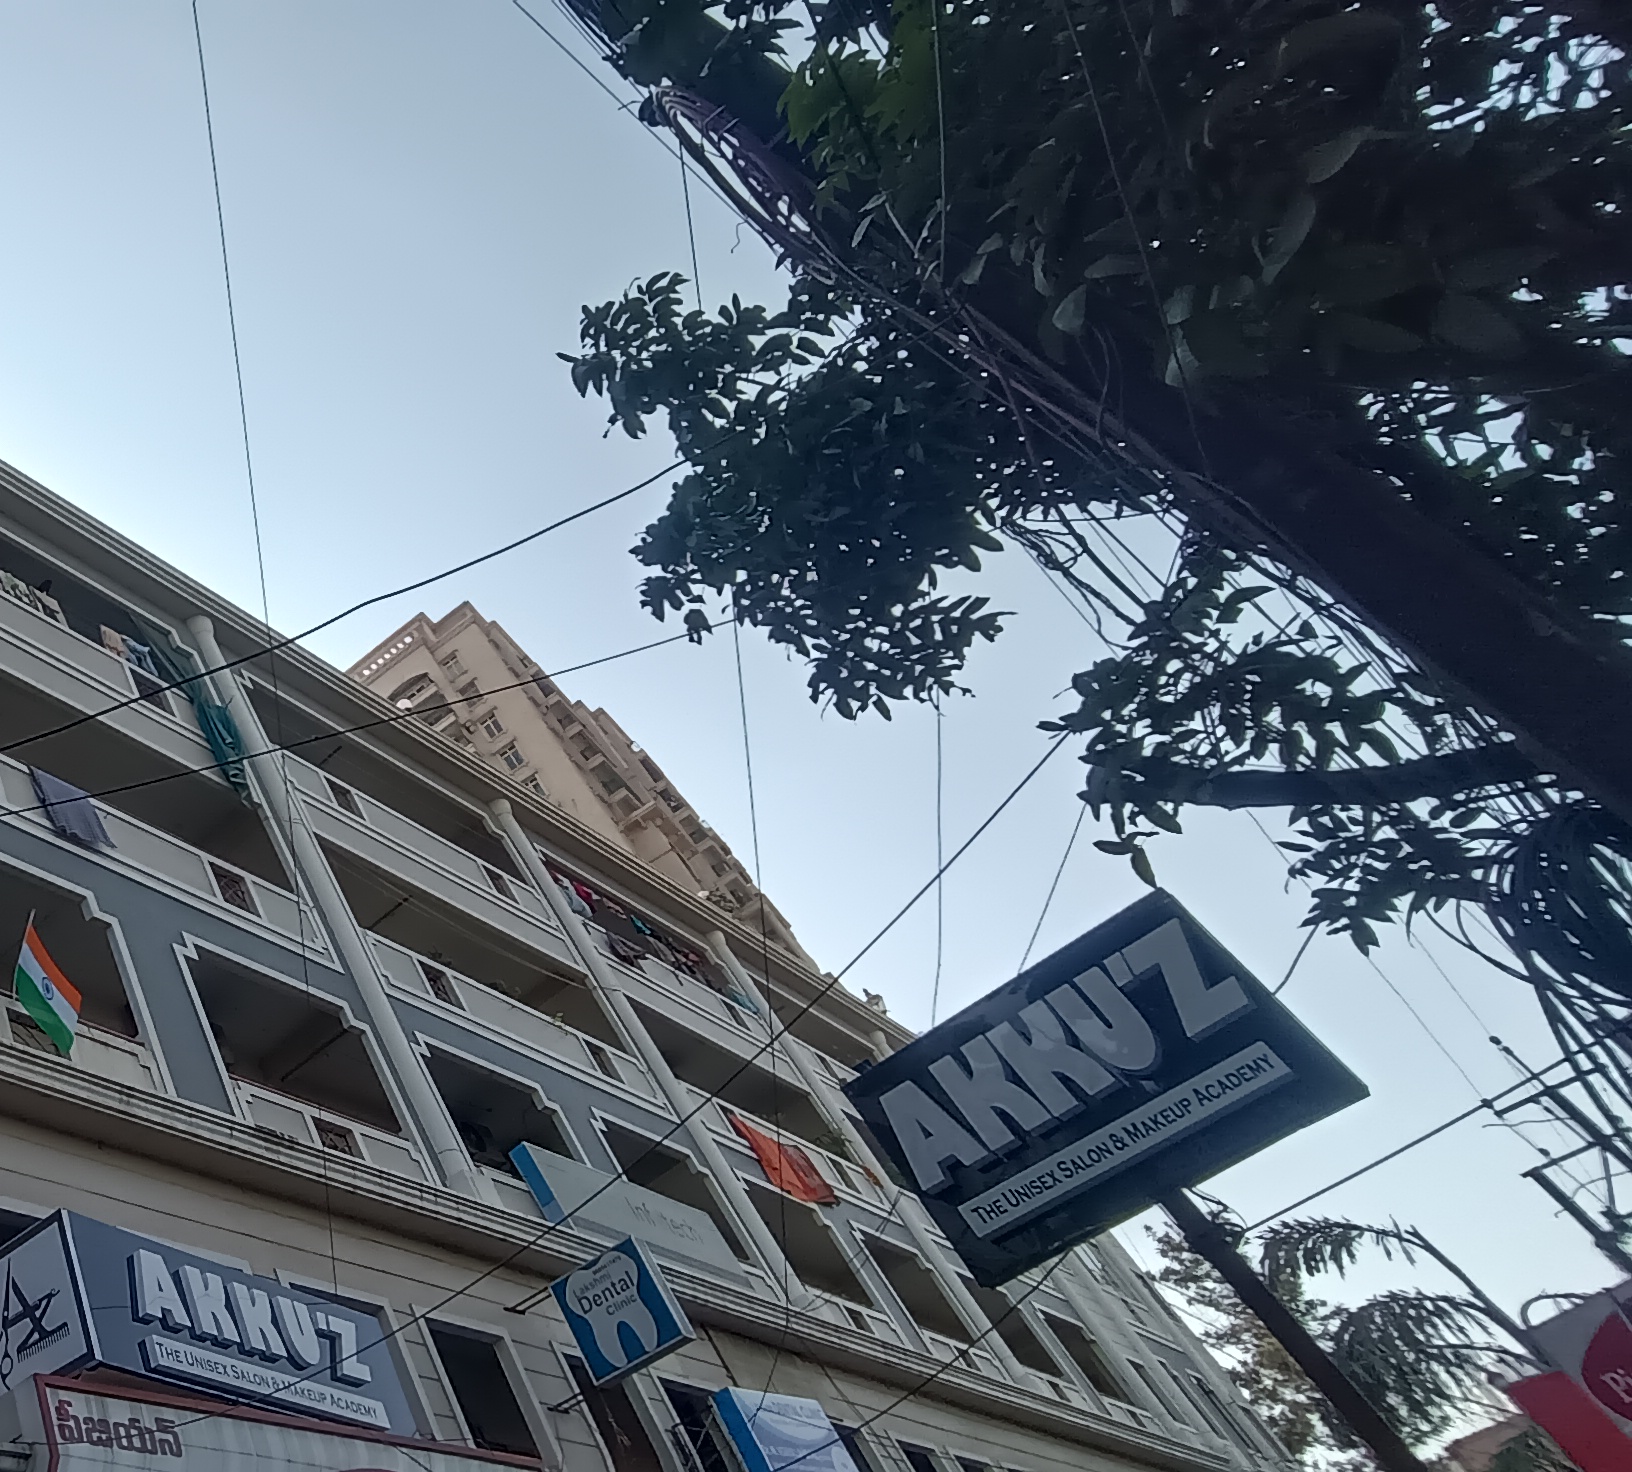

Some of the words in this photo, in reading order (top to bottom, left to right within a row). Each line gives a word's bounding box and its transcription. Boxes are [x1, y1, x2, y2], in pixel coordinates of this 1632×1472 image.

[879, 918, 1249, 1192] AKKU'Z
[970, 1200, 1008, 1225] THE
[1008, 1169, 1064, 1209] UNISEX
[1056, 1140, 1116, 1180] SALON
[1108, 1132, 1128, 1152] &
[1122, 1097, 1193, 1144] MAKEUP
[1193, 1054, 1275, 1107] ACADEMY
[133, 1248, 372, 1384] AKKU'Z
[577, 1270, 635, 1315] Dental
[605, 1294, 638, 1316] Clinic
[157, 1342, 184, 1364] THE
[186, 1351, 230, 1378] UNISEX
[232, 1365, 271, 1389] SALON
[330, 1394, 377, 1418] ACADEMY
